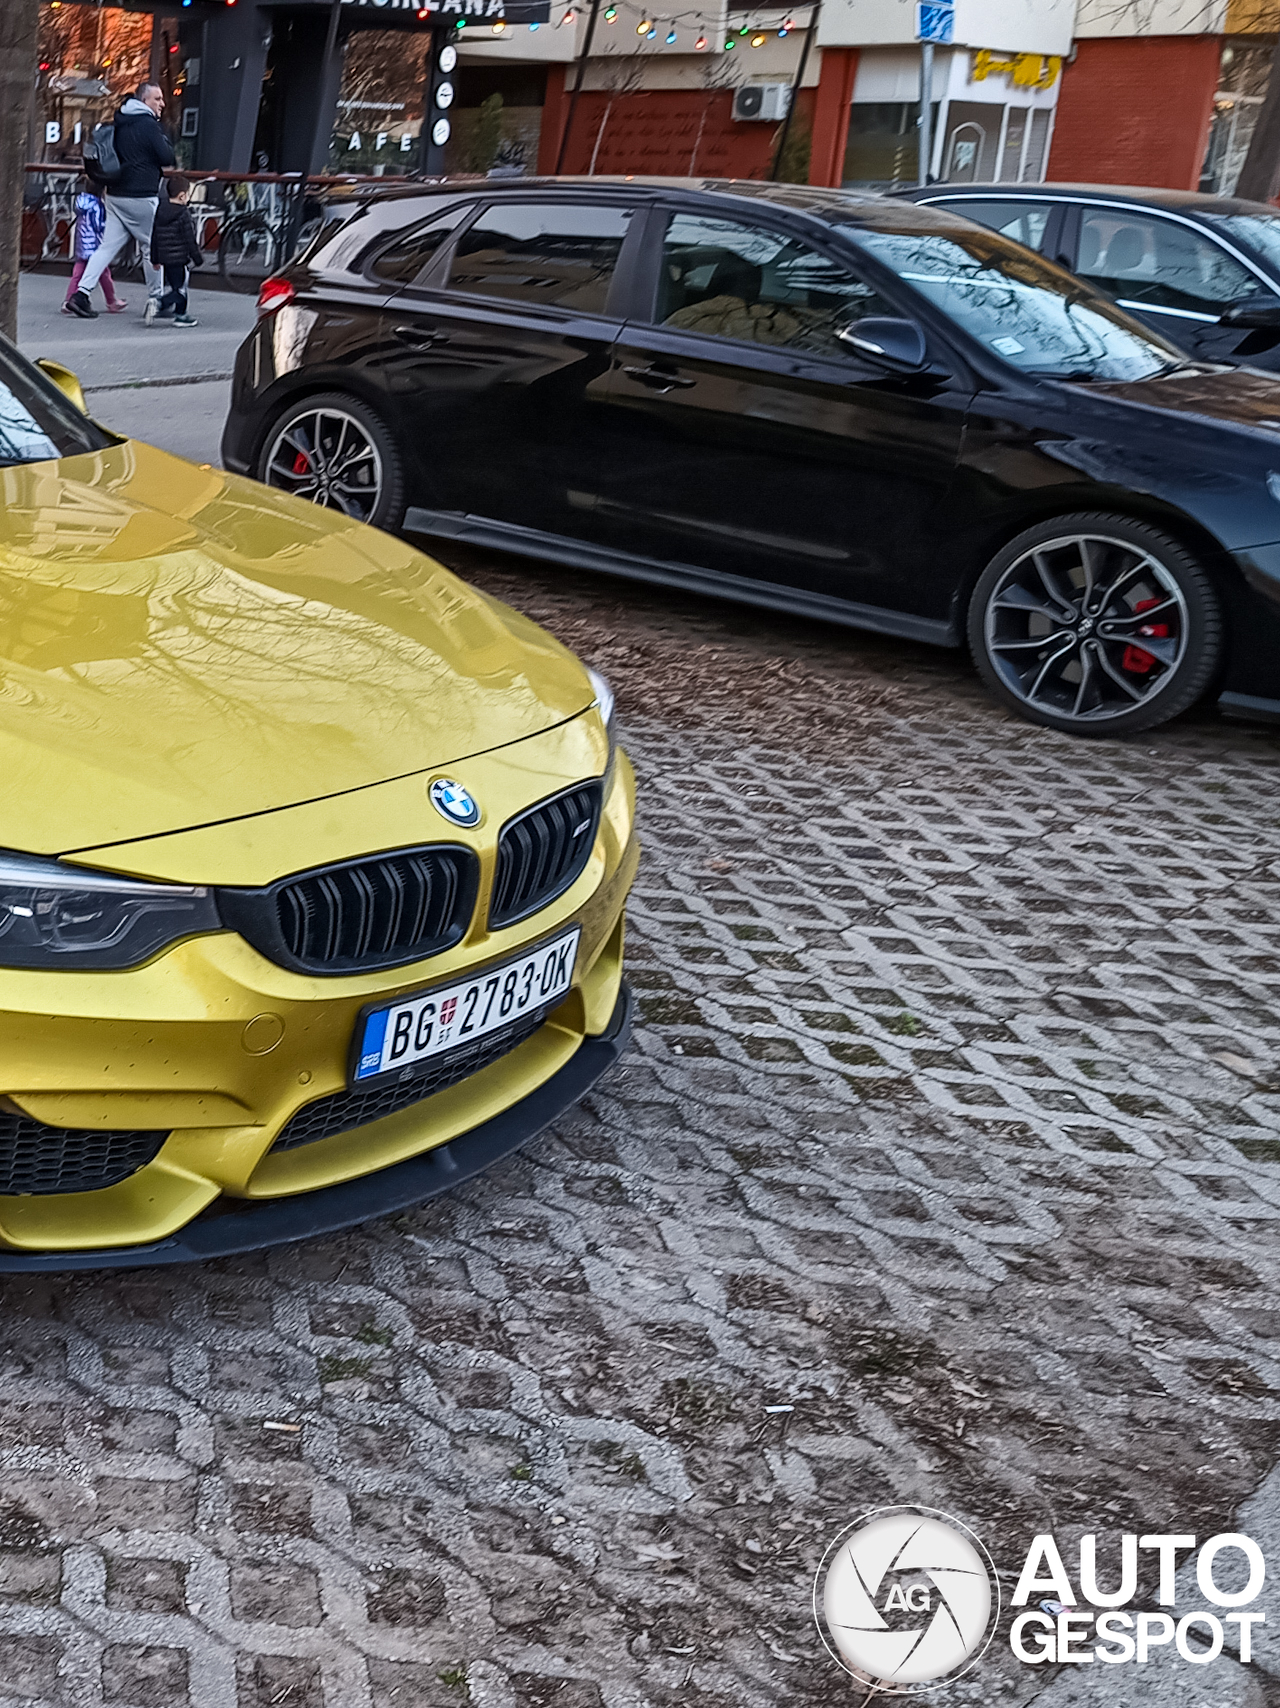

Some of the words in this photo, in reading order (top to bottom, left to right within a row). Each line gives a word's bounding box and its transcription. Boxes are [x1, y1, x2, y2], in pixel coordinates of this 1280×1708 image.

[329, 131, 413, 152] AFE
[389, 1003, 436, 1062] BG
[360, 1051, 381, 1070] SRB
